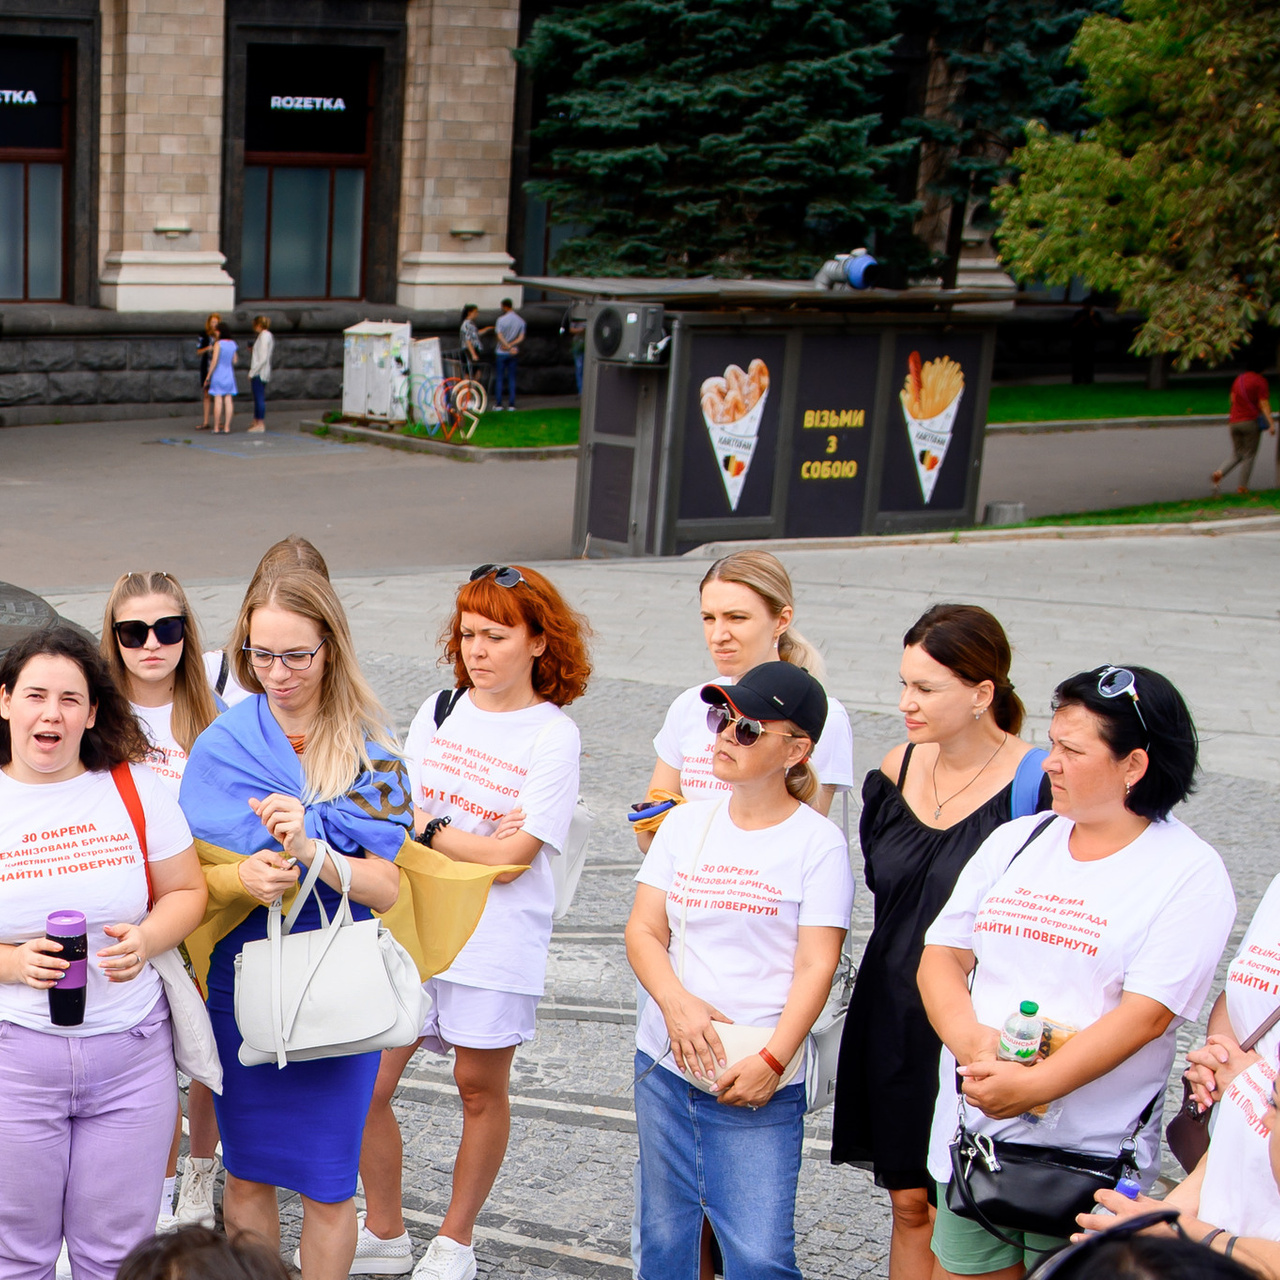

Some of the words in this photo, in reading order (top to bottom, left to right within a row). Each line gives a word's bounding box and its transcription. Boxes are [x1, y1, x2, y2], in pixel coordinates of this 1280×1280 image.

[270, 96, 346, 110] ROZETKA
[803, 409, 865, 428] ВІЗЬМИ
[826, 435, 838, 453] З
[801, 460, 858, 479] СОБОЮ
[441, 752, 477, 769] БРИГАДА
[463, 771, 520, 798] ОСТРОЗЬКОГО
[439, 791, 446, 801] І
[450, 794, 506, 821] ПОВЕРНУ
[21, 833, 37, 843] 30
[41, 823, 97, 840] ОКРЕМА
[81, 832, 130, 847] БРИГАДА
[73, 844, 133, 859] Острозького
[48, 868, 53, 877] І
[57, 854, 136, 876] ПОВЕРНУТИ
[701, 864, 715, 873] 30
[717, 865, 759, 876] ОКРЕМА
[739, 879, 783, 896] БРИГАДА
[1014, 887, 1031, 896] 30
[704, 900, 708, 908] І
[710, 900, 778, 916] ПОВЕРНУТИ
[987, 908, 1038, 922] Костянтина
[1040, 916, 1101, 939] Острозького
[1059, 908, 1108, 927] БРИГАДА
[1015, 926, 1019, 936] І
[1023, 927, 1098, 957] ПОВЕРНУТИ
[1272, 984, 1279, 995] І
